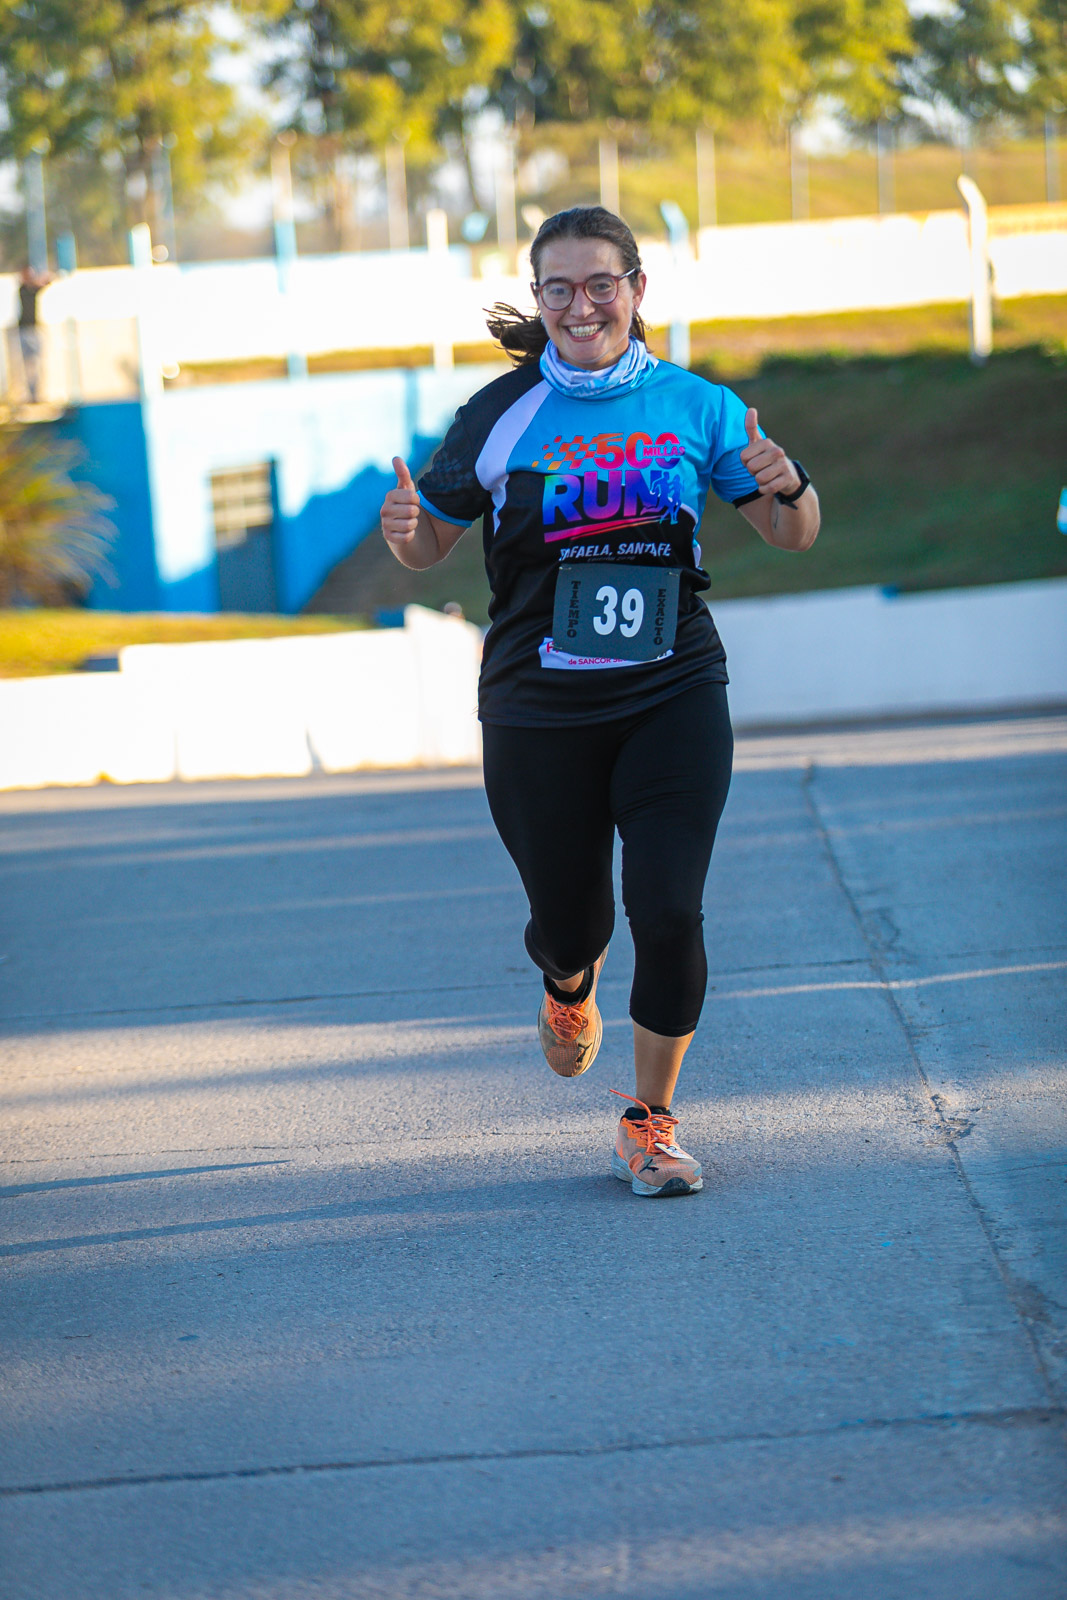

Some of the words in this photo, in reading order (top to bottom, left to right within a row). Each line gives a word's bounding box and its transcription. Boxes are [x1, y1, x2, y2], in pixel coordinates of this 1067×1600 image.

[643, 446, 686, 457] MILLAS
[542, 470, 664, 525] RUN
[567, 580, 581, 638] TIEMPO
[593, 585, 645, 638] 39
[653, 588, 667, 645] EXACTO
